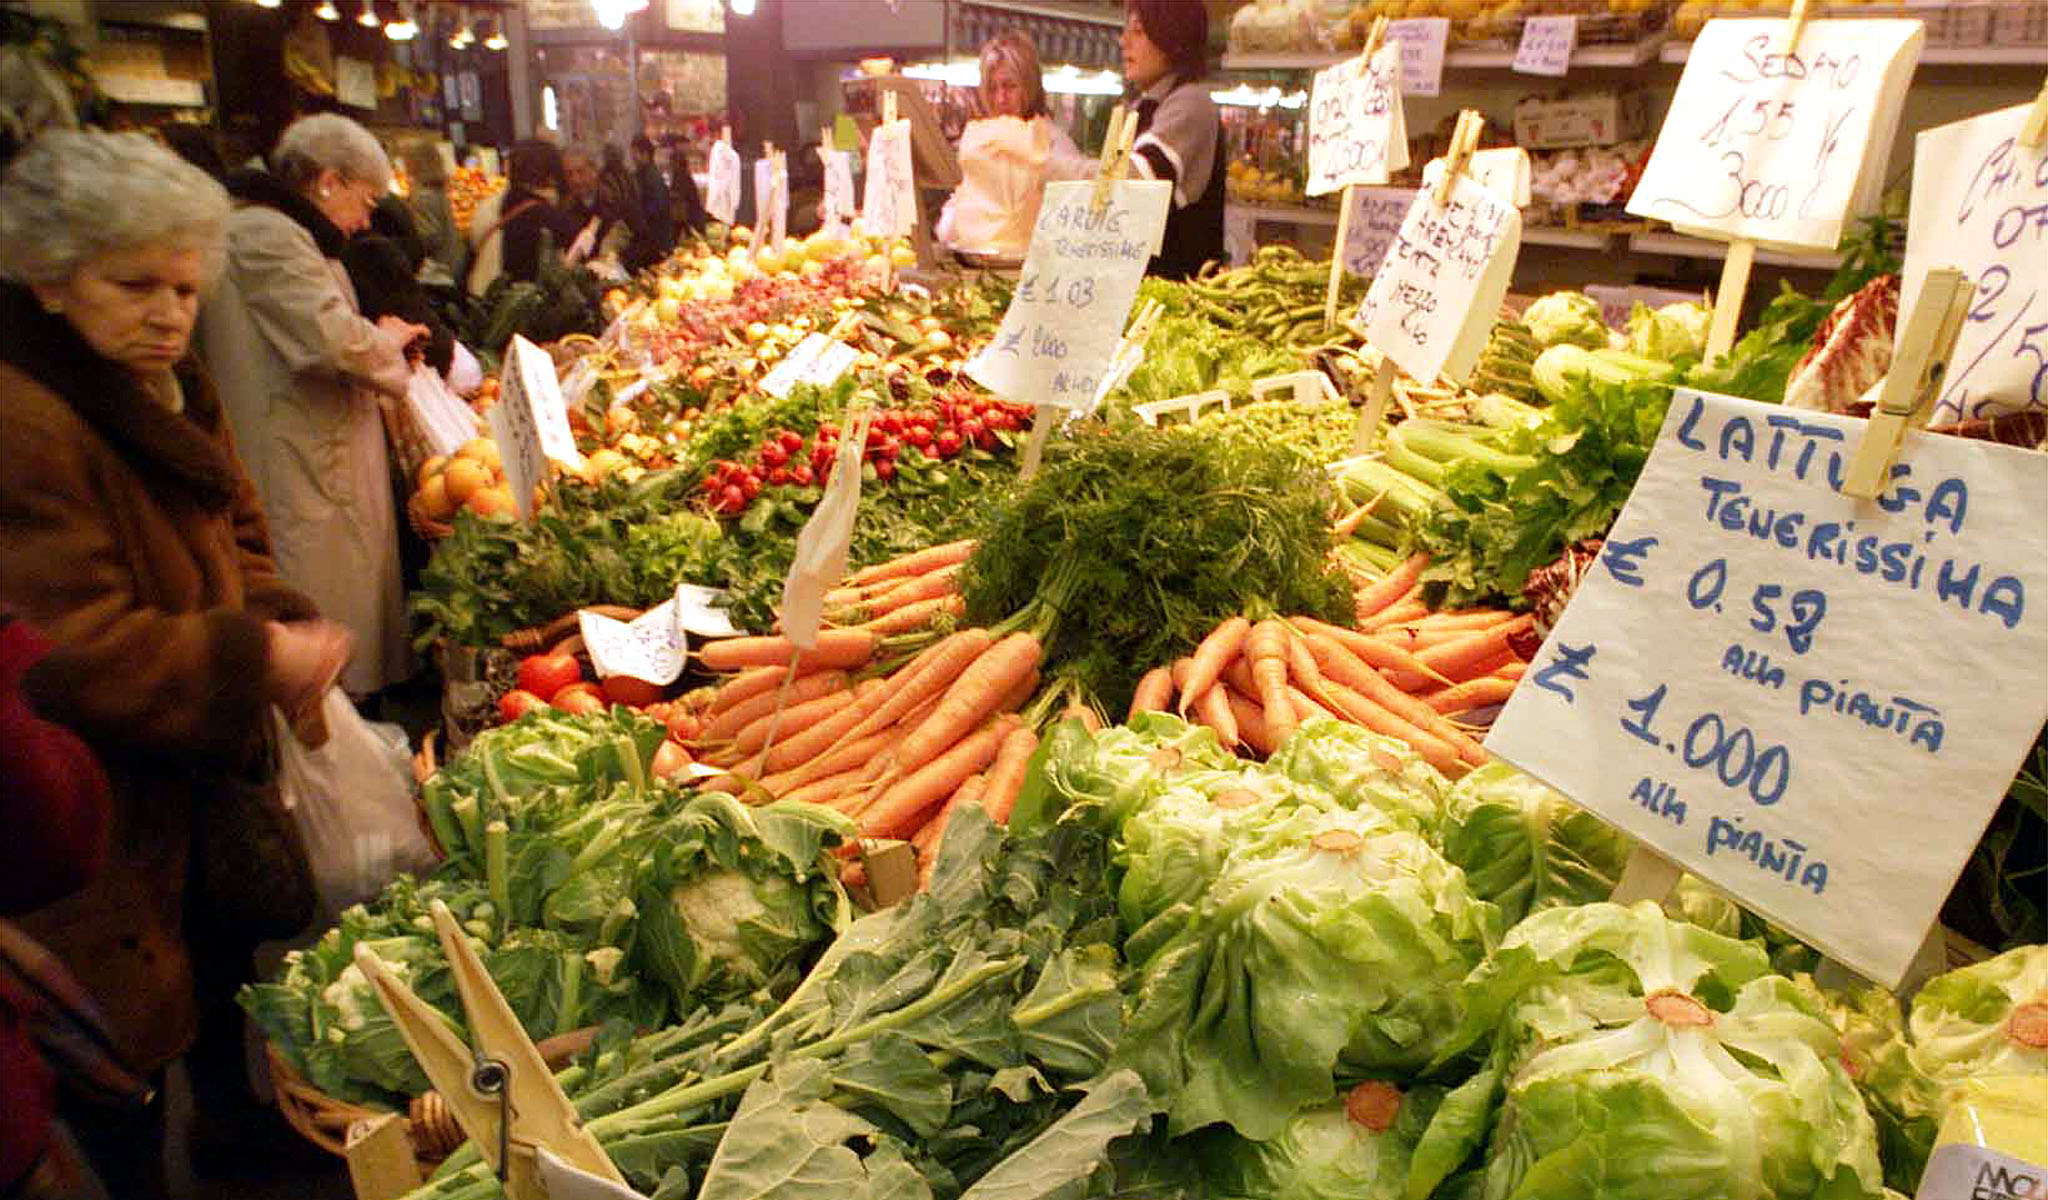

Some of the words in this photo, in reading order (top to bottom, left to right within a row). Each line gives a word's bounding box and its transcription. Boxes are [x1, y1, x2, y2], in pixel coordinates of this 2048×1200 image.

[1601, 536, 1659, 587] €
[1701, 475, 2025, 629] TENERISSIMA
[1619, 683, 1791, 806] 1.000
